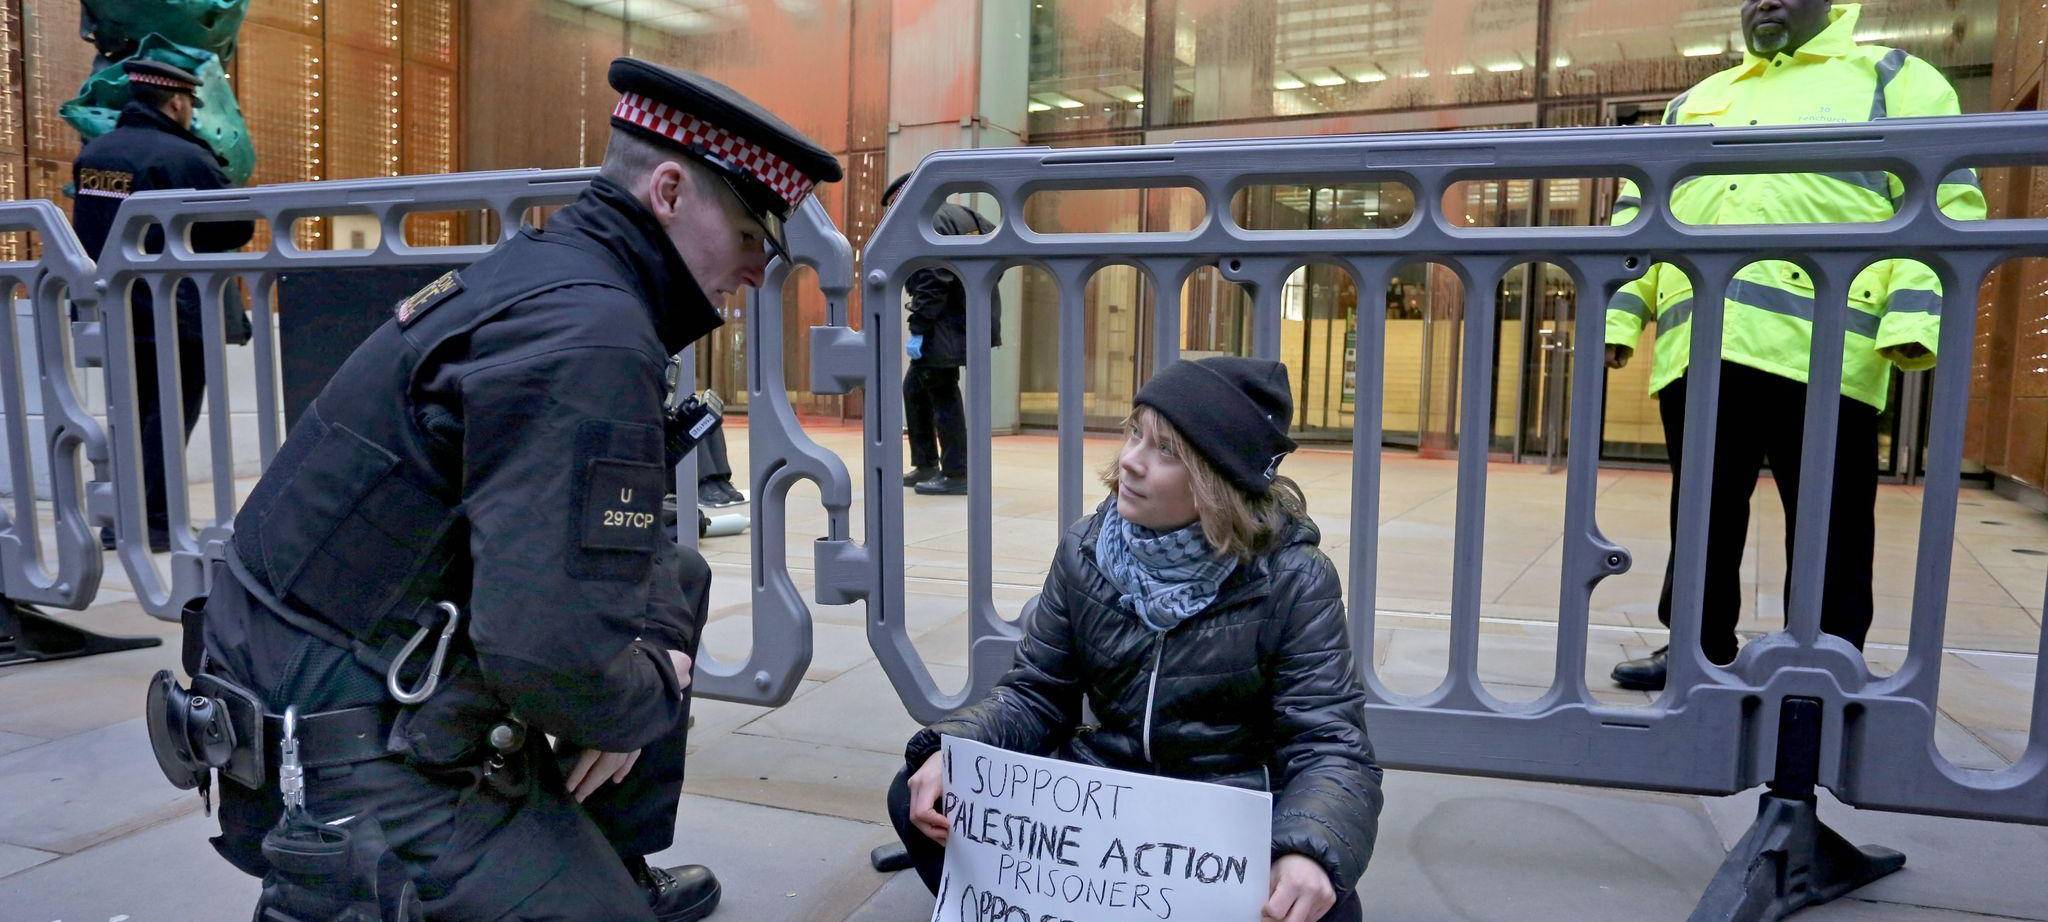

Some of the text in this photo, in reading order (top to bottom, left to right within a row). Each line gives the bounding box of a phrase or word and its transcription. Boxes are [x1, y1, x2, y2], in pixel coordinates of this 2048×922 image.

[80, 174, 131, 193] POLICE
[621, 487, 633, 503] U
[603, 510, 654, 529] 297CP
[971, 755, 1133, 819] SUPPORT
[944, 791, 1248, 884] PALESTINE ACTION
[998, 854, 1175, 920] PRISONERS
